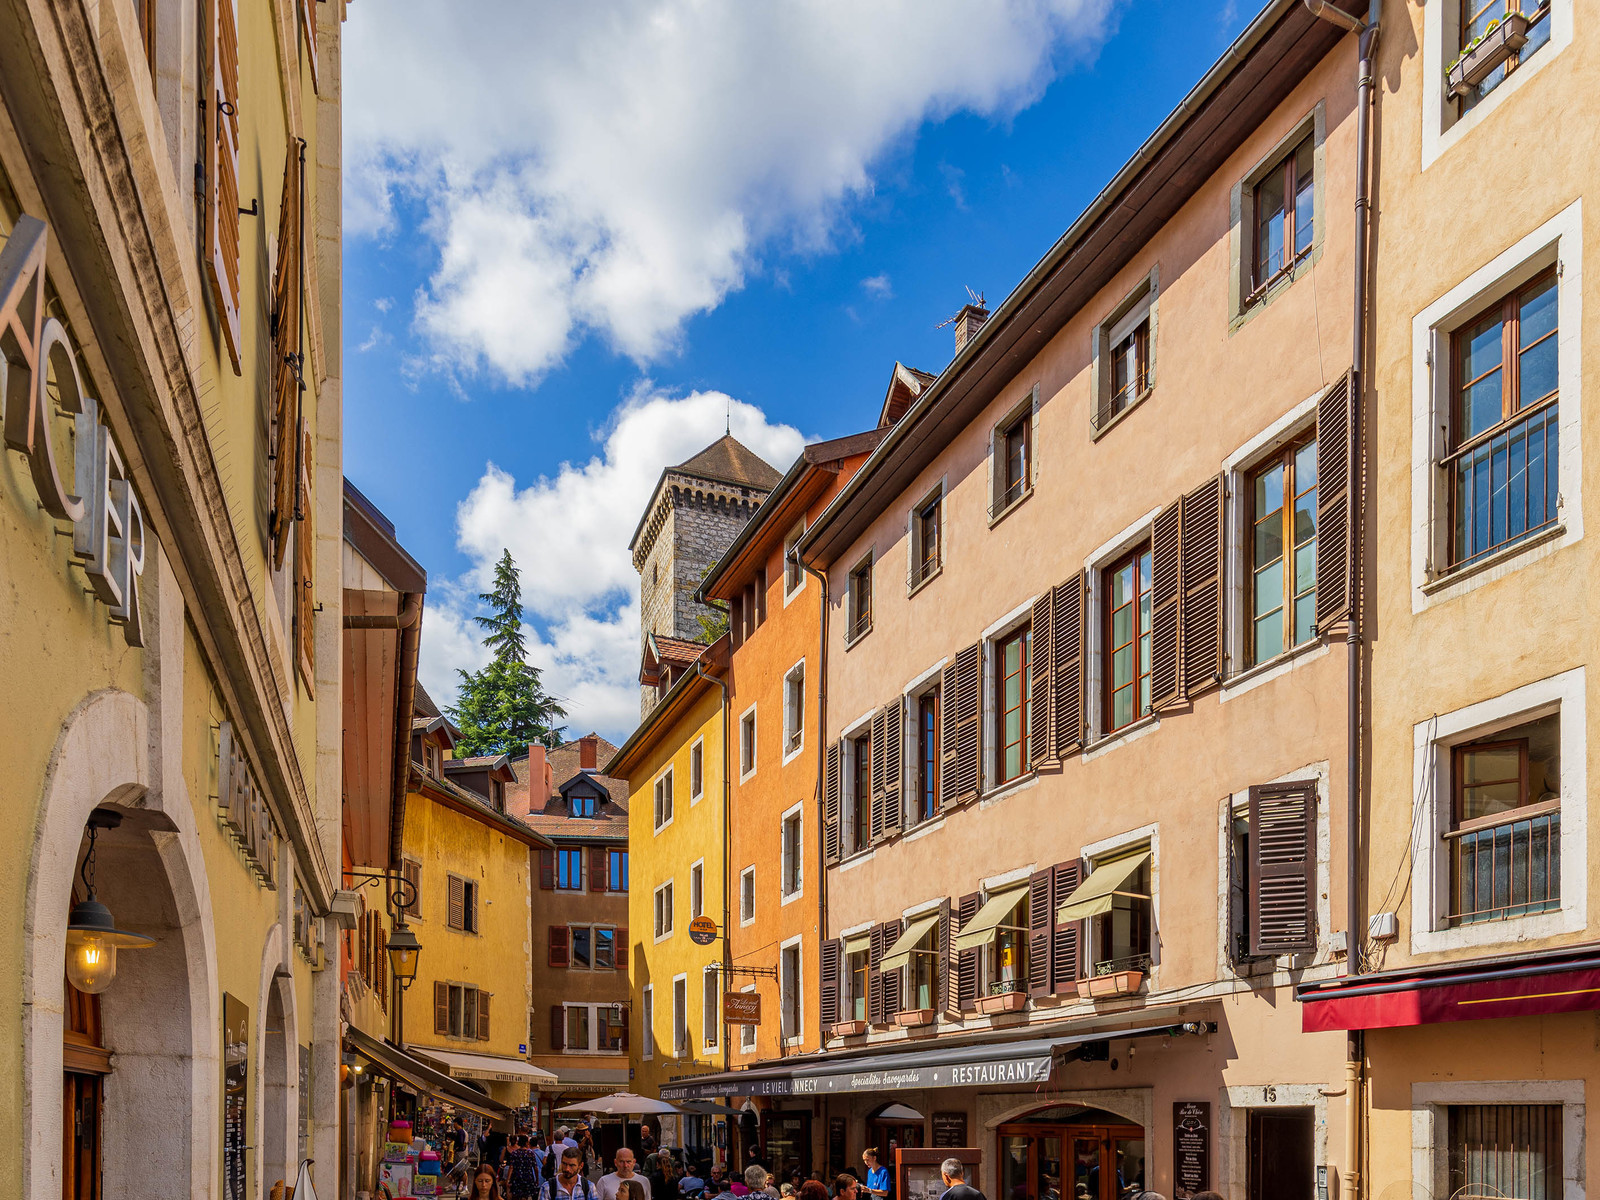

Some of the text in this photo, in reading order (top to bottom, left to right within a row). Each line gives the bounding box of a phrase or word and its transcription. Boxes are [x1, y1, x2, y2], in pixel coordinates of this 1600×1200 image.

[693, 921, 713, 929] HOTEL
[952, 1062, 1035, 1083] RESTAURANT
[660, 1088, 688, 1100] RESTAURANT
[762, 1079, 818, 1094] LE VIEIL ANNECY
[1262, 1085, 1277, 1103] 15
